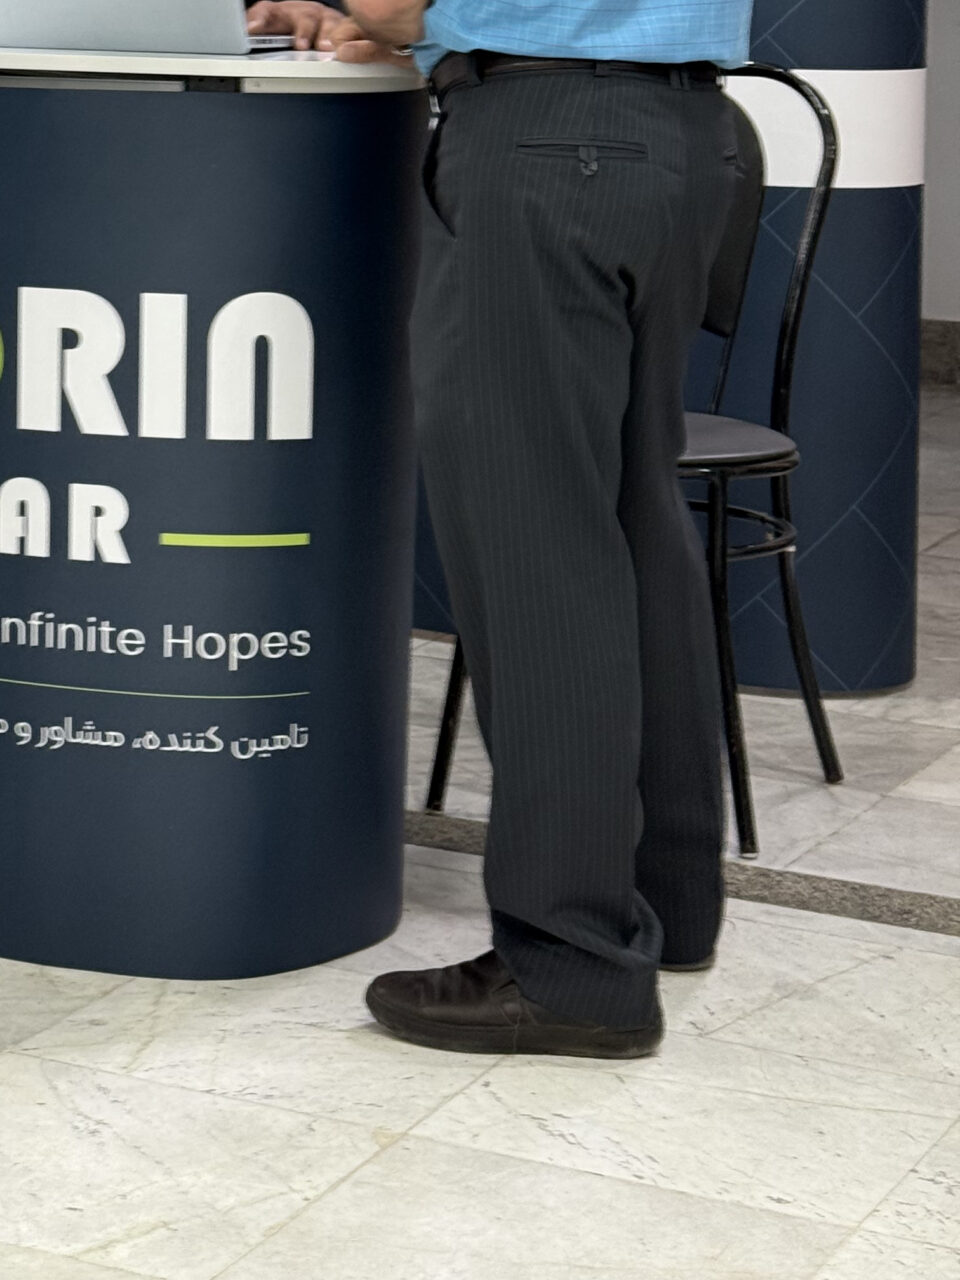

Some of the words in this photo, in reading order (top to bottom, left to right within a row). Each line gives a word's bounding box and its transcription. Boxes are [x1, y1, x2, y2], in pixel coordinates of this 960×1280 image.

[162, 624, 311, 671] Hopes
[13, 721, 32, 746] و
[34, 716, 125, 750] مشاور
